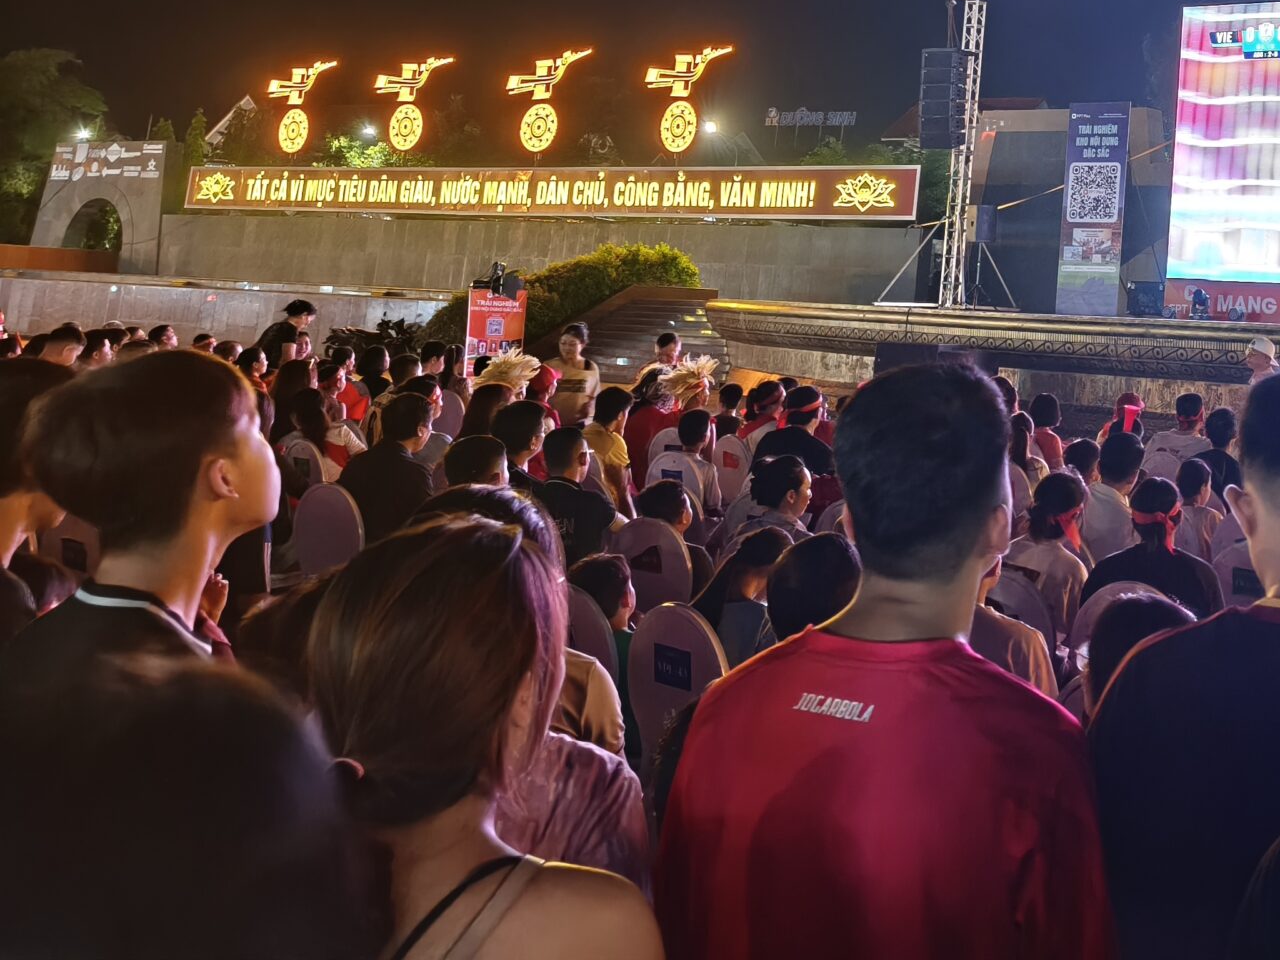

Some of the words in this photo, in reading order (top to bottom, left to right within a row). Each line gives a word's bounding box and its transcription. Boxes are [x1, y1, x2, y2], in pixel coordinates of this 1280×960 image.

[1216, 32, 1233, 43] VIE
[1246, 27, 1255, 42] 0
[826, 111, 857, 126] SINH
[246, 171, 269, 201] TẤT
[270, 171, 289, 201] CẢ
[290, 174, 305, 201] VÌ
[305, 179, 335, 207] MỤC
[338, 174, 367, 203] TIÊU
[368, 174, 399, 203] DÂN
[400, 174, 436, 207] GIÀU,
[440, 175, 480, 204] NƯỚC
[482, 180, 532, 212] MẠNH,
[535, 175, 569, 205] DÂN
[572, 171, 608, 208] CHỦ,
[613, 176, 660, 206] CÔNG
[720, 175, 757, 207] VĂN
[759, 180, 816, 208] MINH!
[1217, 294, 1278, 314] MANG
